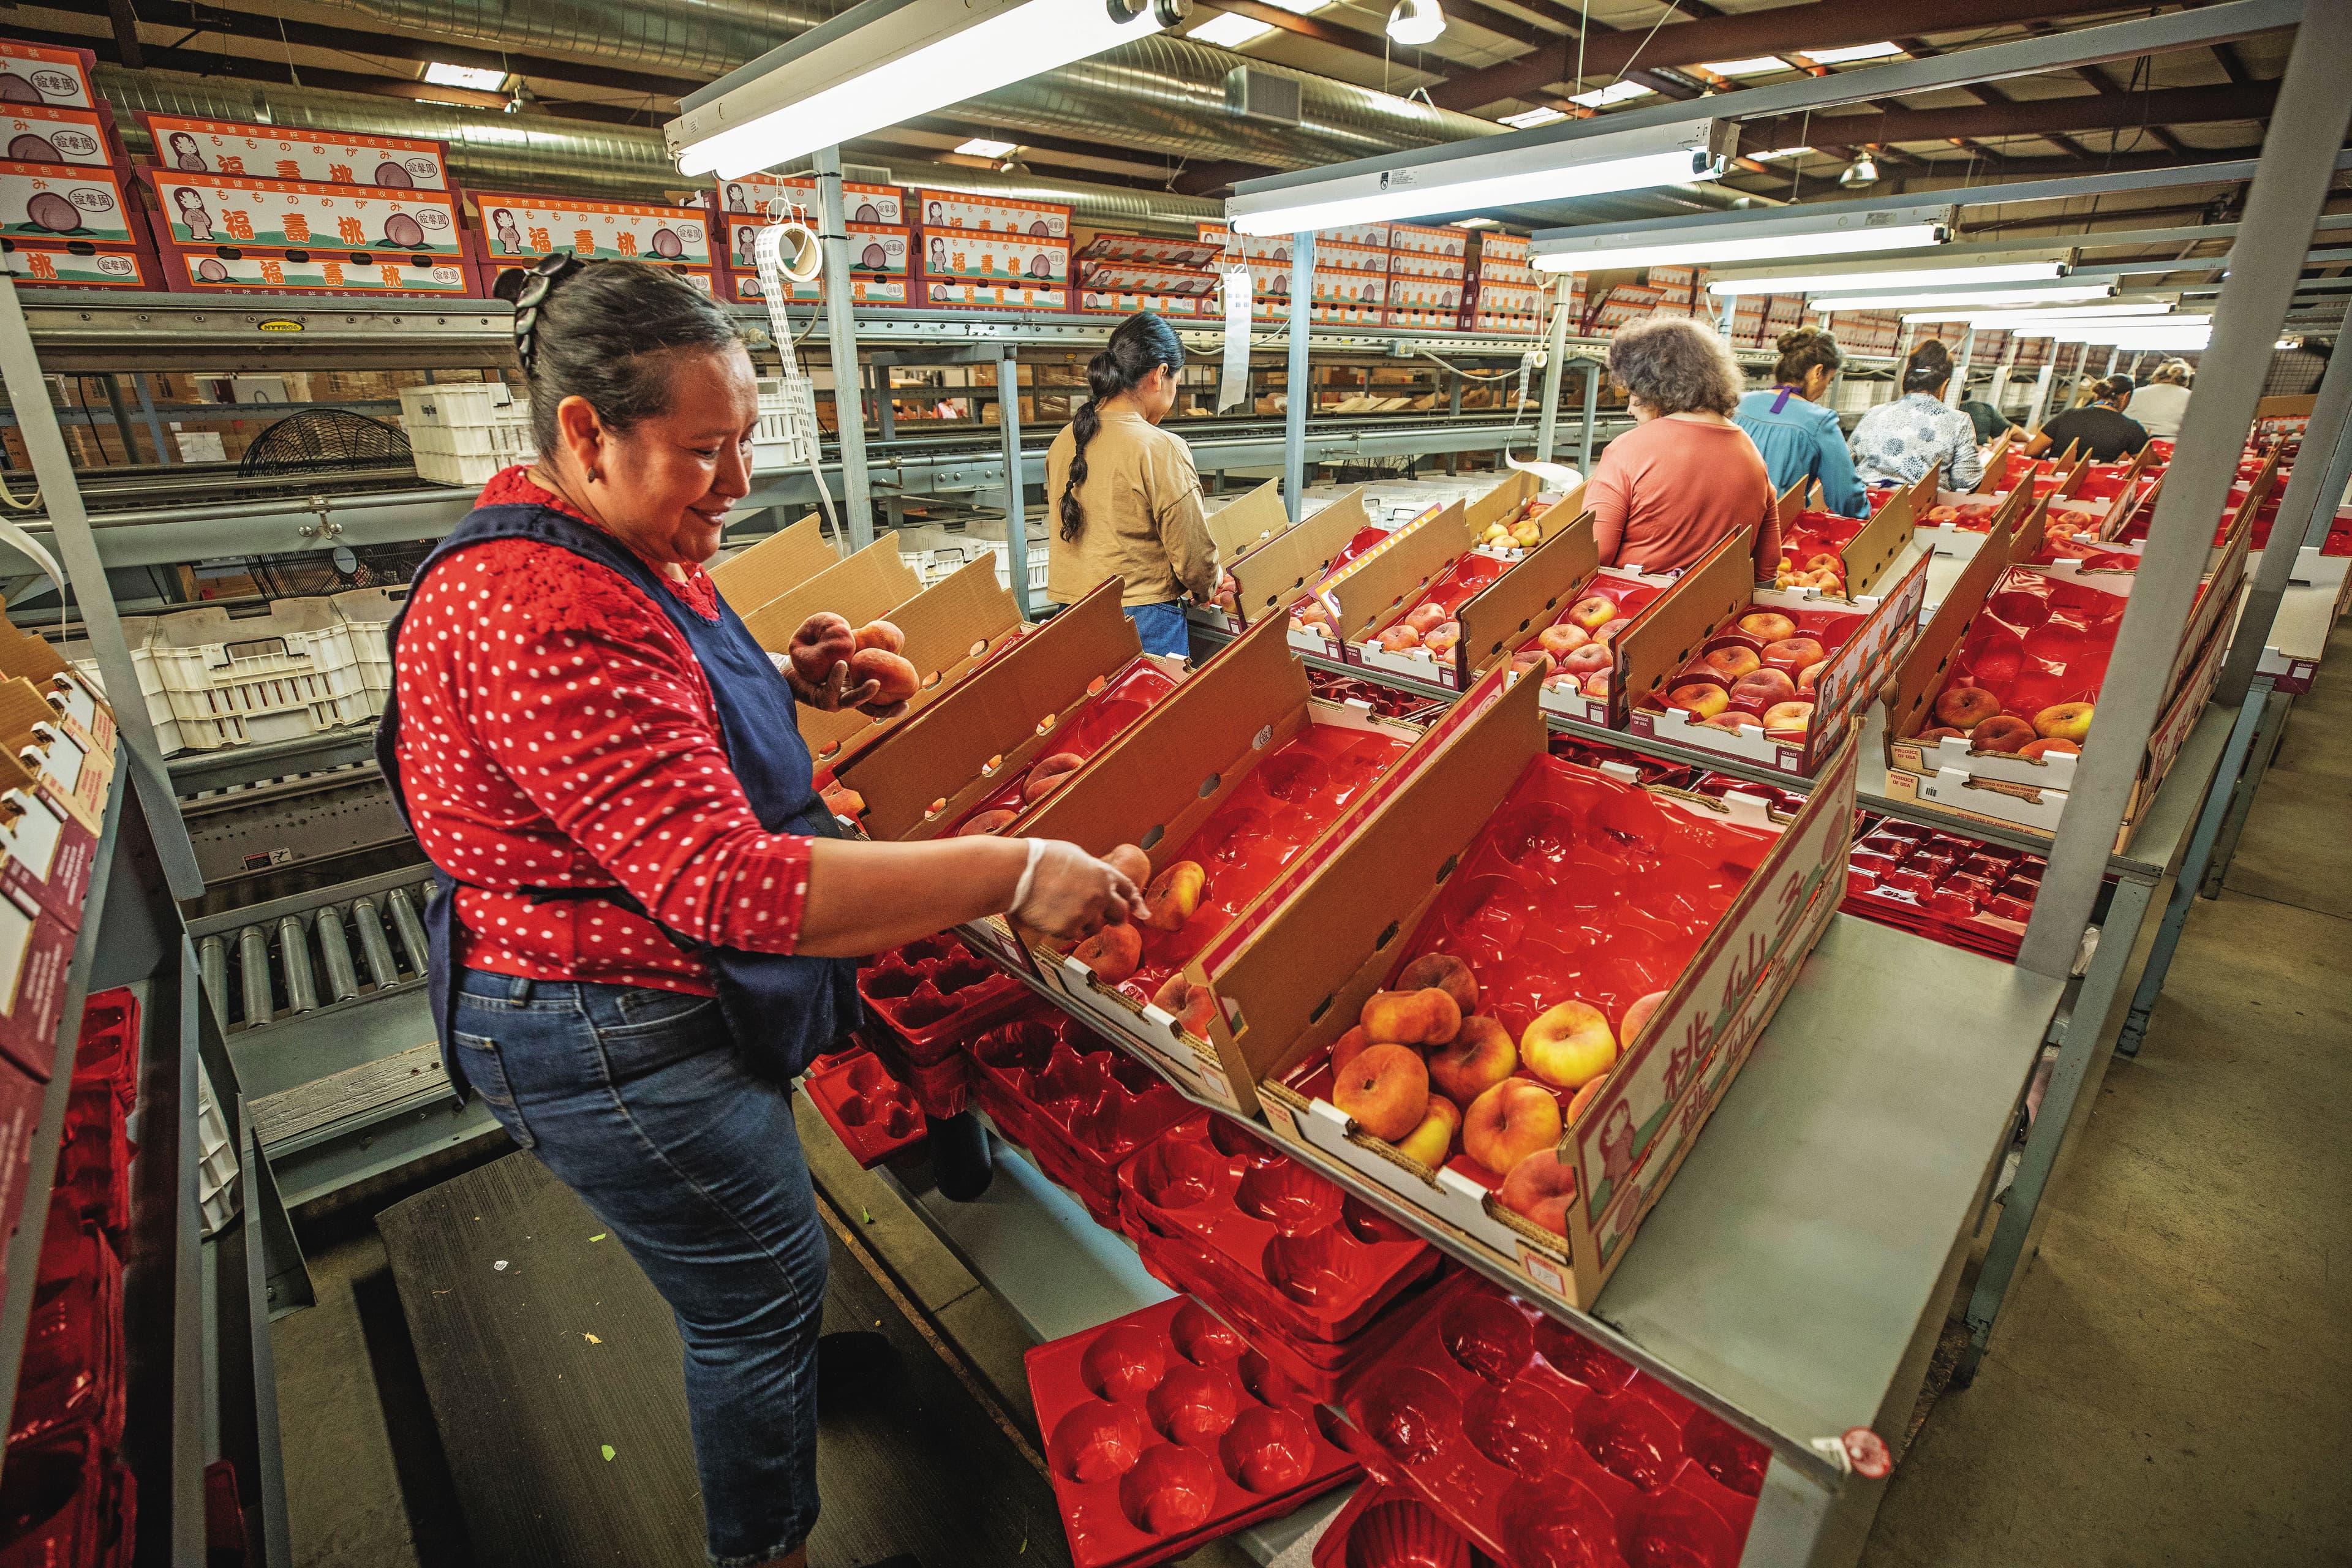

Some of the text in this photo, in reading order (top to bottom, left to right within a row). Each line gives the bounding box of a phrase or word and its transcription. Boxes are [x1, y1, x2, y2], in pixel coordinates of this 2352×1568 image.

[13, 120, 31, 131] み
[211, 135, 391, 160] もものめがみ
[32, 179, 49, 189] み
[216, 189, 402, 211] もものめがみ
[221, 209, 366, 245] 福壽桃
[528, 226, 639, 257] 福壽桃
[26, 253, 58, 279] 桃
[259, 260, 402, 288] 福壽桃
[952, 252, 1020, 276] 福壽桃
[964, 286, 1034, 307] 福壽桃
[1891, 774, 1914, 783] PRODUCE
